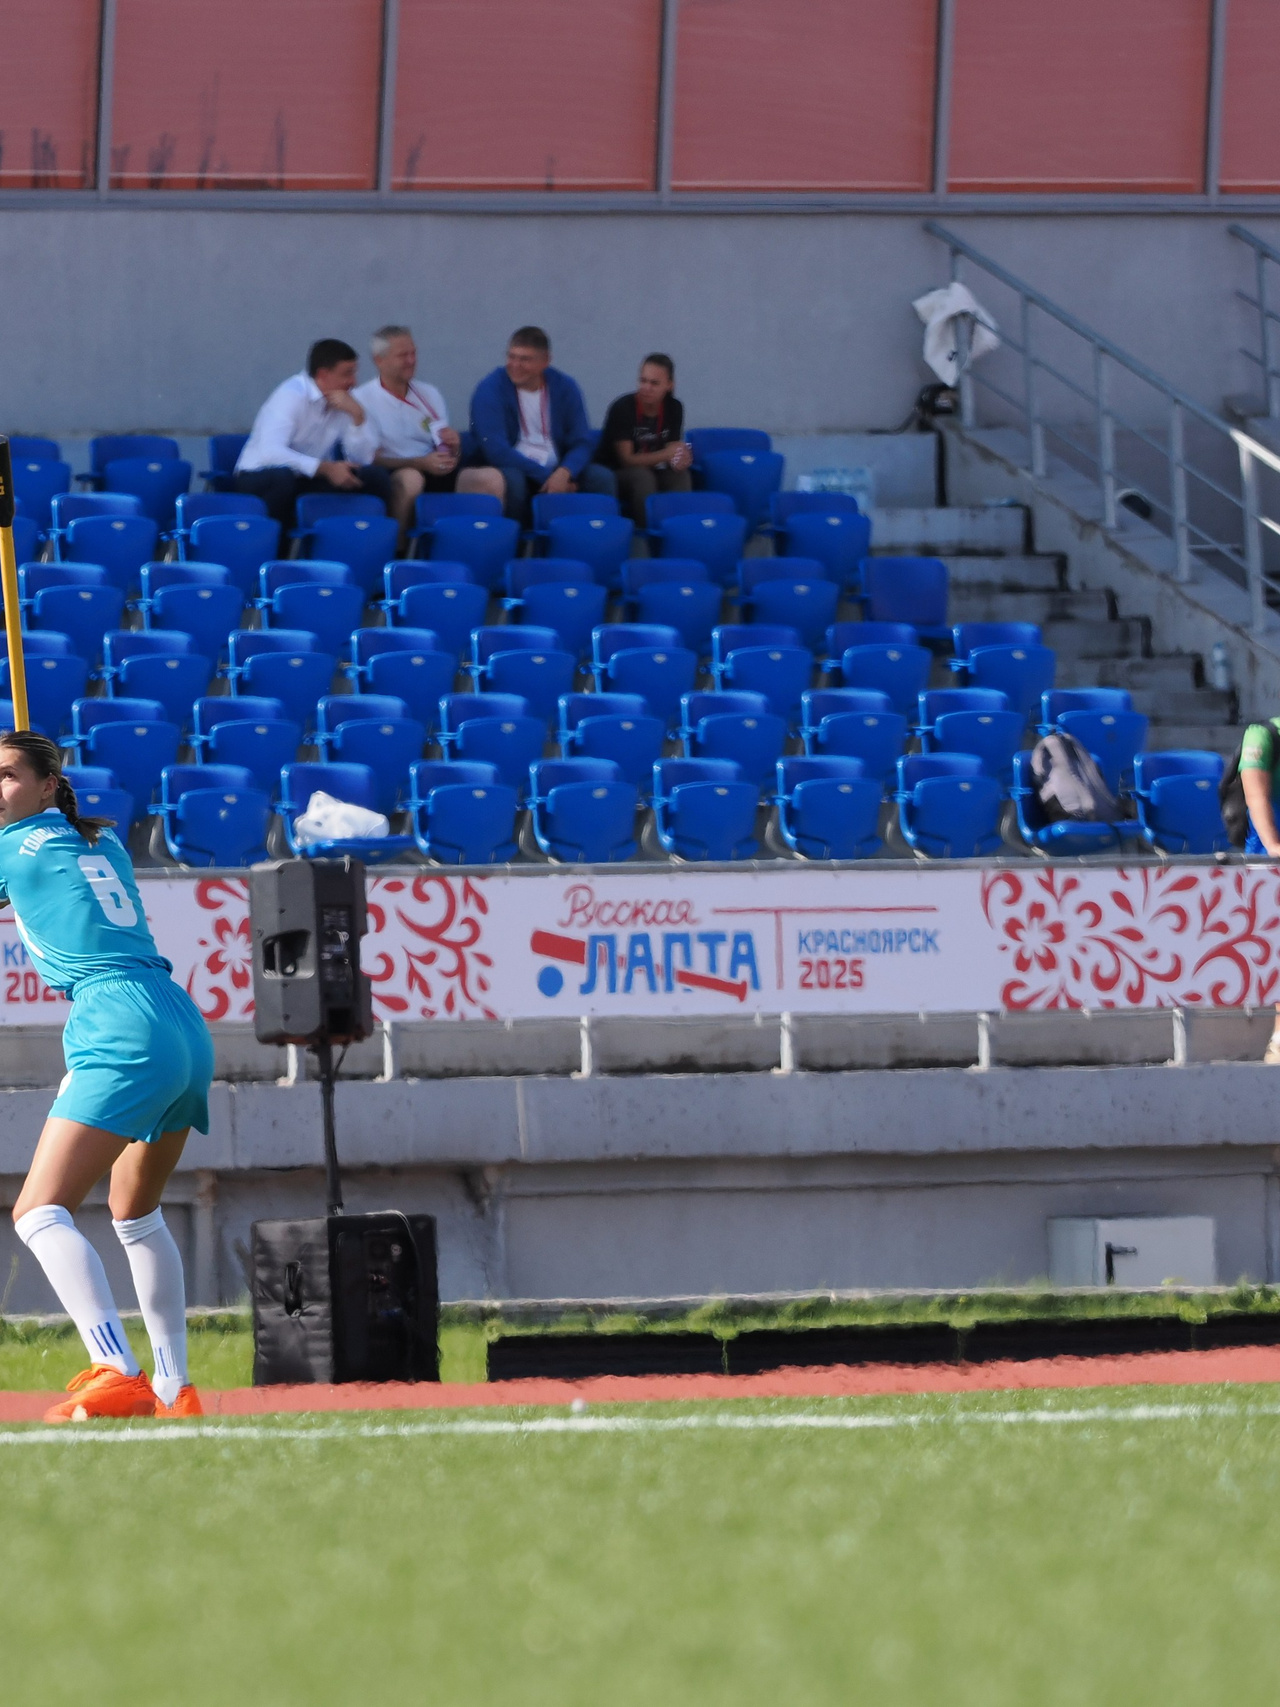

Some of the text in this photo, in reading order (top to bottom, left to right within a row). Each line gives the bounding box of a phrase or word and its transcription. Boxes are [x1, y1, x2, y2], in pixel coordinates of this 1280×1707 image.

[77, 854, 138, 927] 8
[558, 884, 702, 927] Русская
[797, 927, 941, 955] КРАСНОЯРСК
[579, 932, 761, 995] ЛАПТА
[798, 959, 865, 990] 2025
[5, 971, 67, 1002] 202
